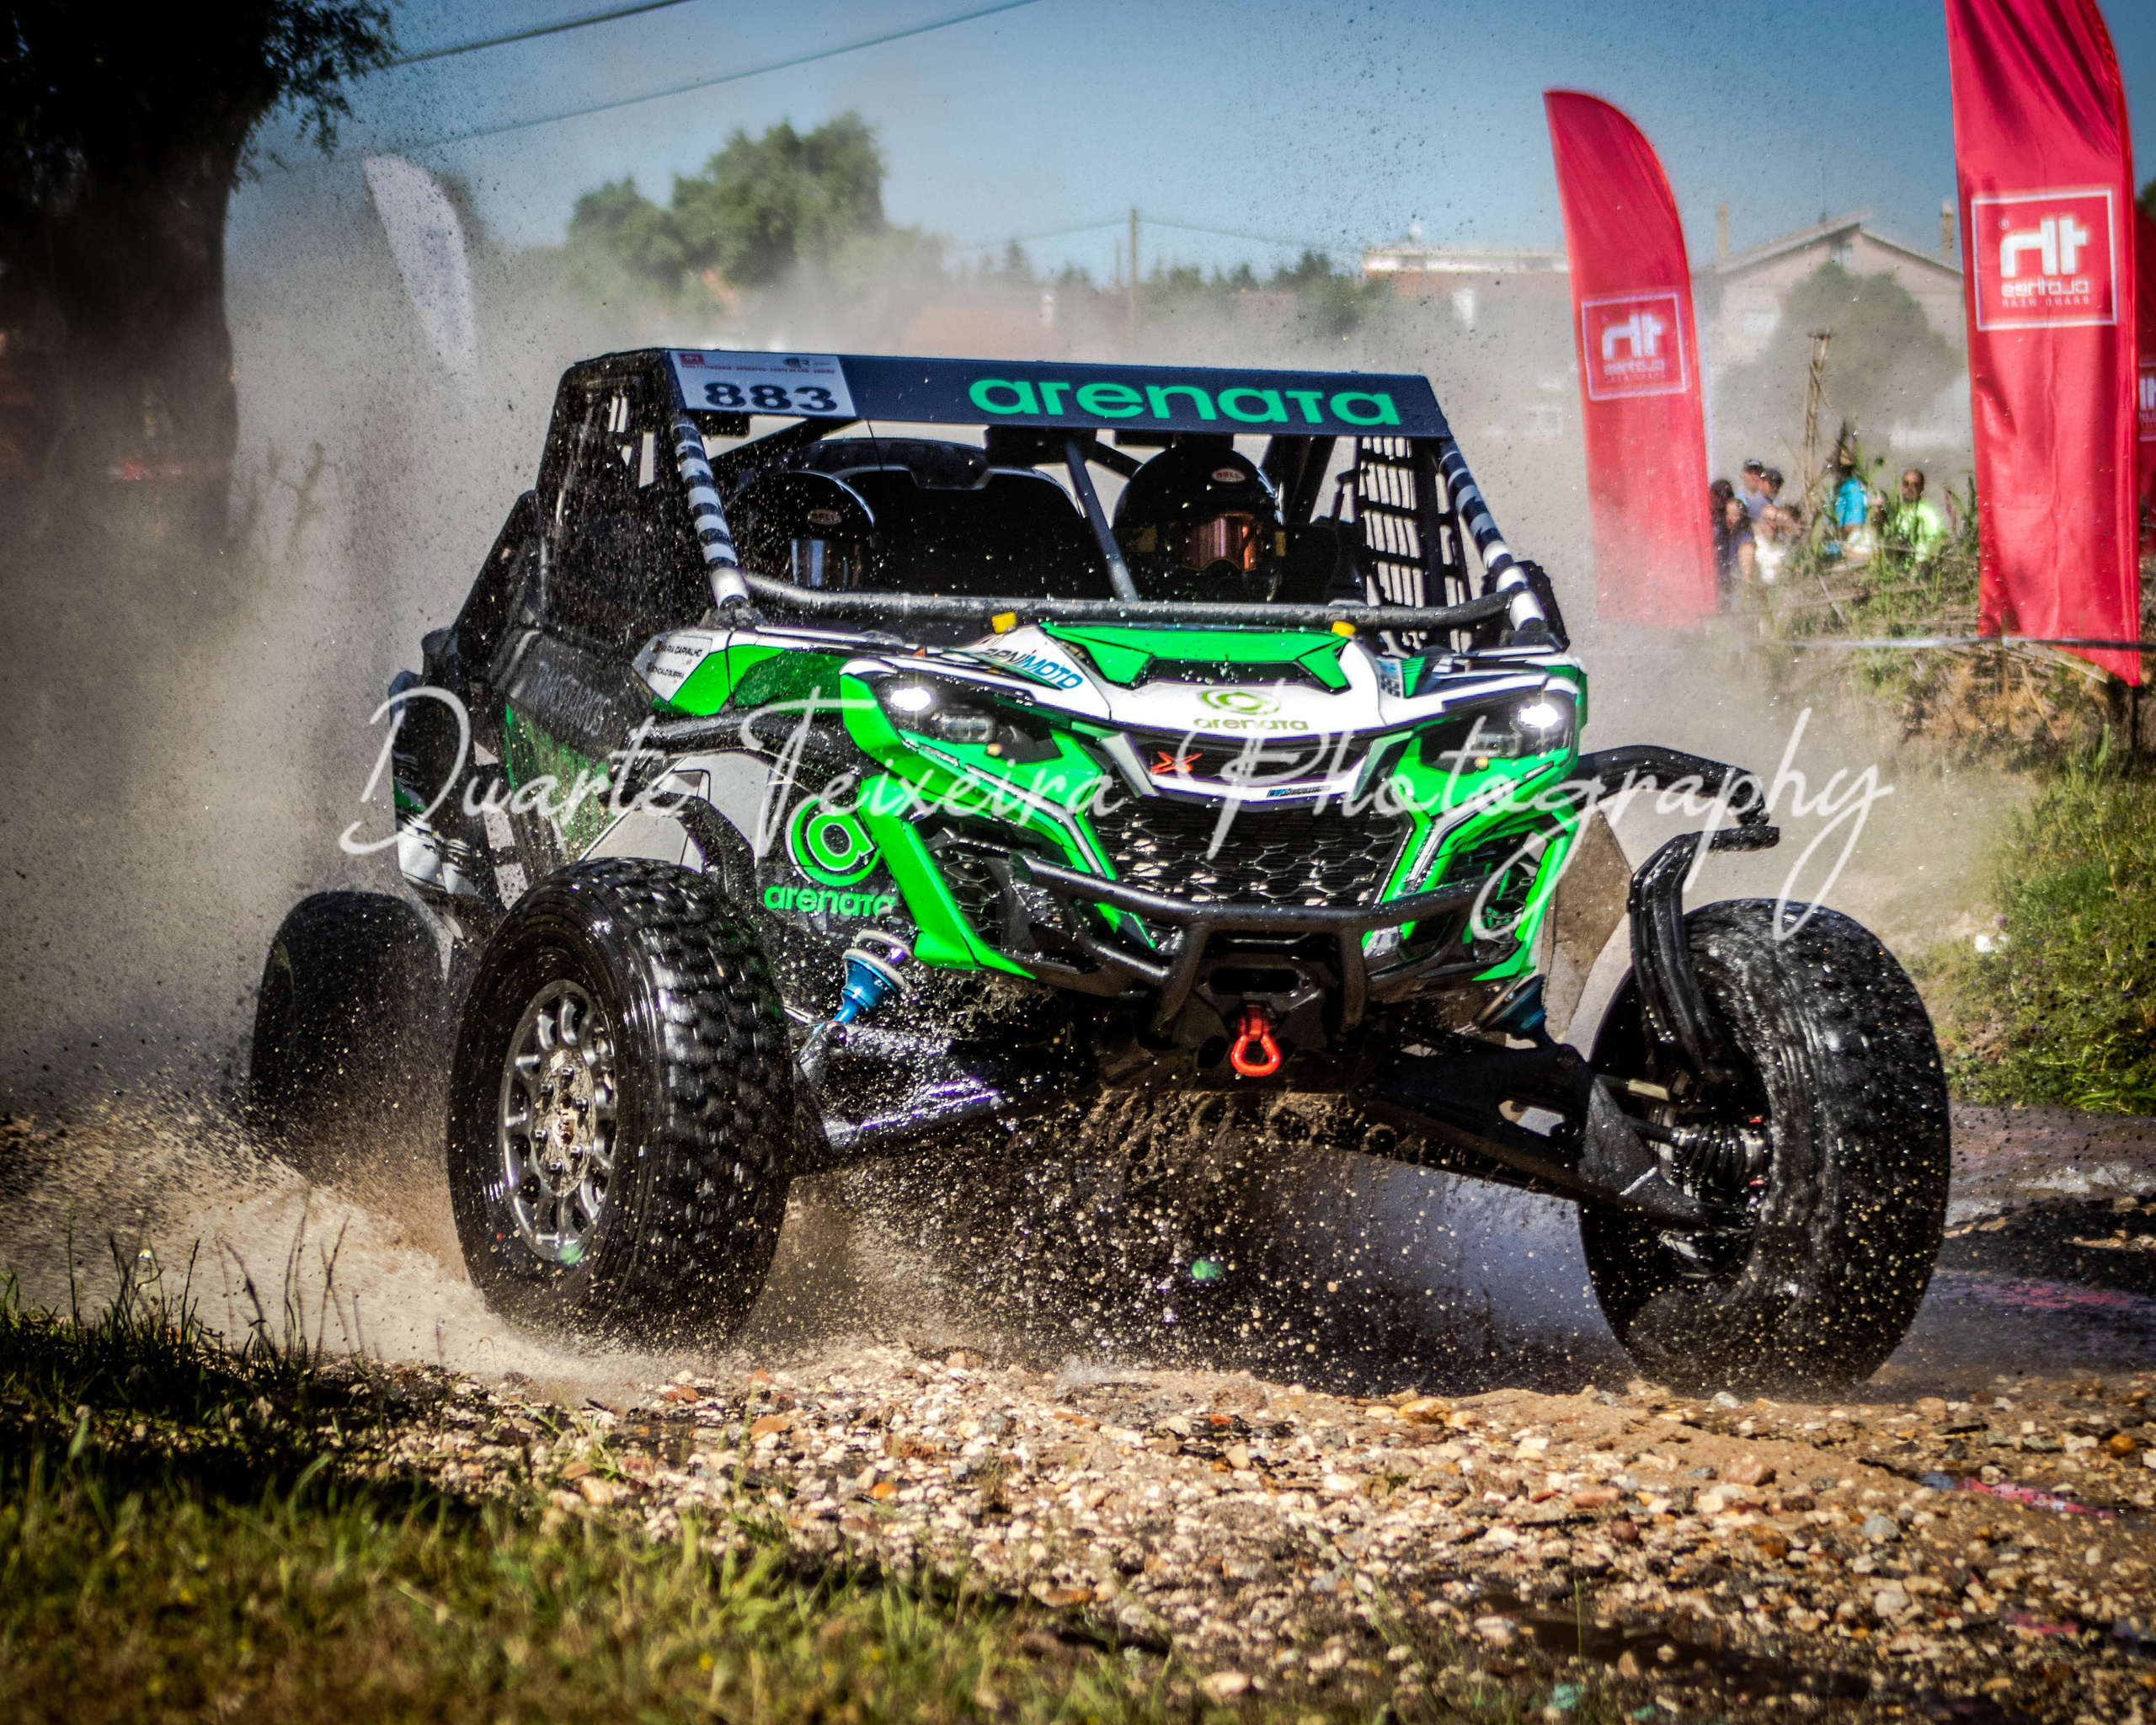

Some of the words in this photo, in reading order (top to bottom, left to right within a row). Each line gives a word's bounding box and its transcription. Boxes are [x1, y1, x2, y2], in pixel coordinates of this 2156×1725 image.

[703, 382, 838, 413] 883
[968, 377, 1401, 426] arenata
[1193, 718, 1309, 731] arenata
[764, 884, 896, 916] arenata
